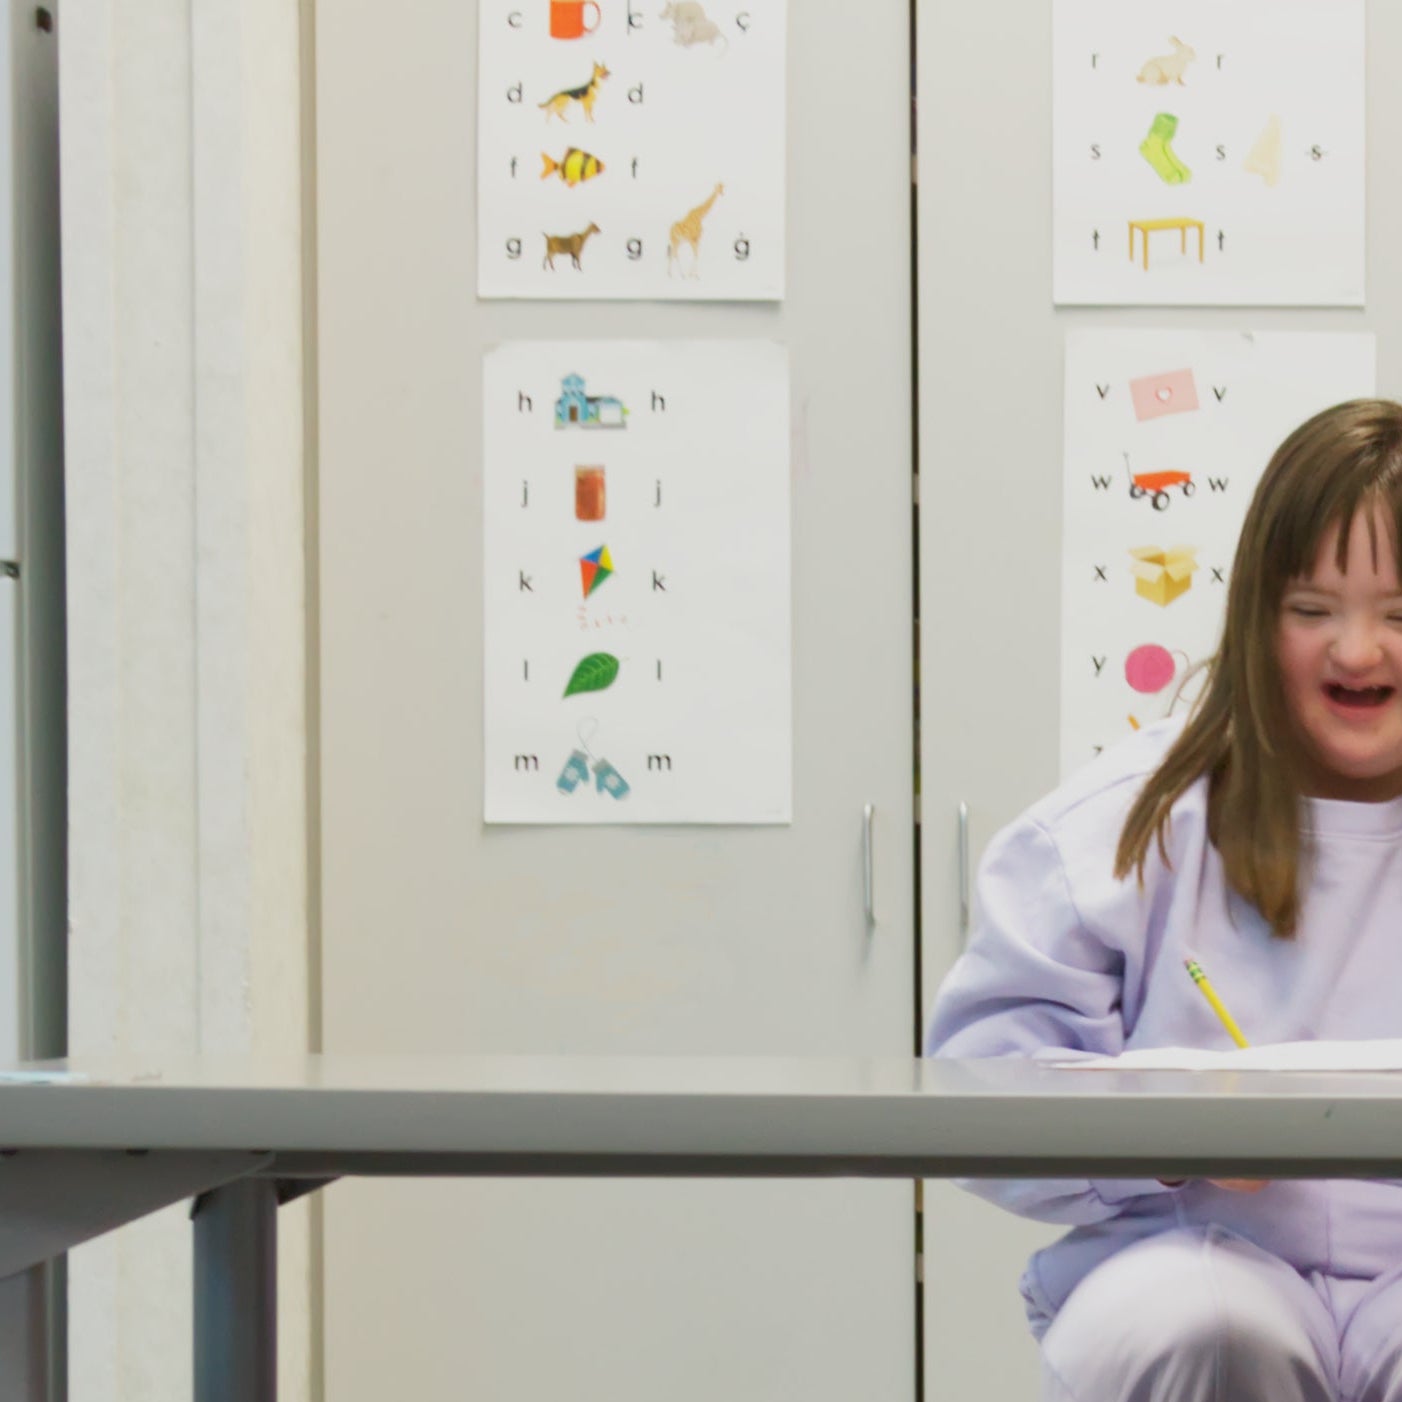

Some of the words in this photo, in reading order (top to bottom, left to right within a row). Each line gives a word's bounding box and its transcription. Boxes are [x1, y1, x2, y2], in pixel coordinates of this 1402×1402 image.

[507, 11, 522, 28] c
[506, 80, 523, 104] d
[627, 81, 644, 104] d
[1090, 144, 1101, 160] s
[1216, 144, 1226, 161] s
[510, 156, 518, 178] f
[630, 156, 638, 179] f
[505, 236, 522, 261] g
[626, 236, 643, 261] g
[1092, 228, 1100, 251] t
[1216, 229, 1226, 252] t
[518, 390, 533, 413] h
[650, 390, 666, 412] h
[1095, 384, 1110, 400] v
[1212, 386, 1227, 403] v
[1090, 474, 1113, 491] w
[1207, 477, 1230, 493] w
[519, 569, 533, 592] k
[651, 569, 666, 592] k
[1093, 565, 1108, 583] x
[1211, 567, 1225, 585] x
[1091, 656, 1107, 678] y
[513, 753, 539, 772] m
[646, 753, 672, 772] m
